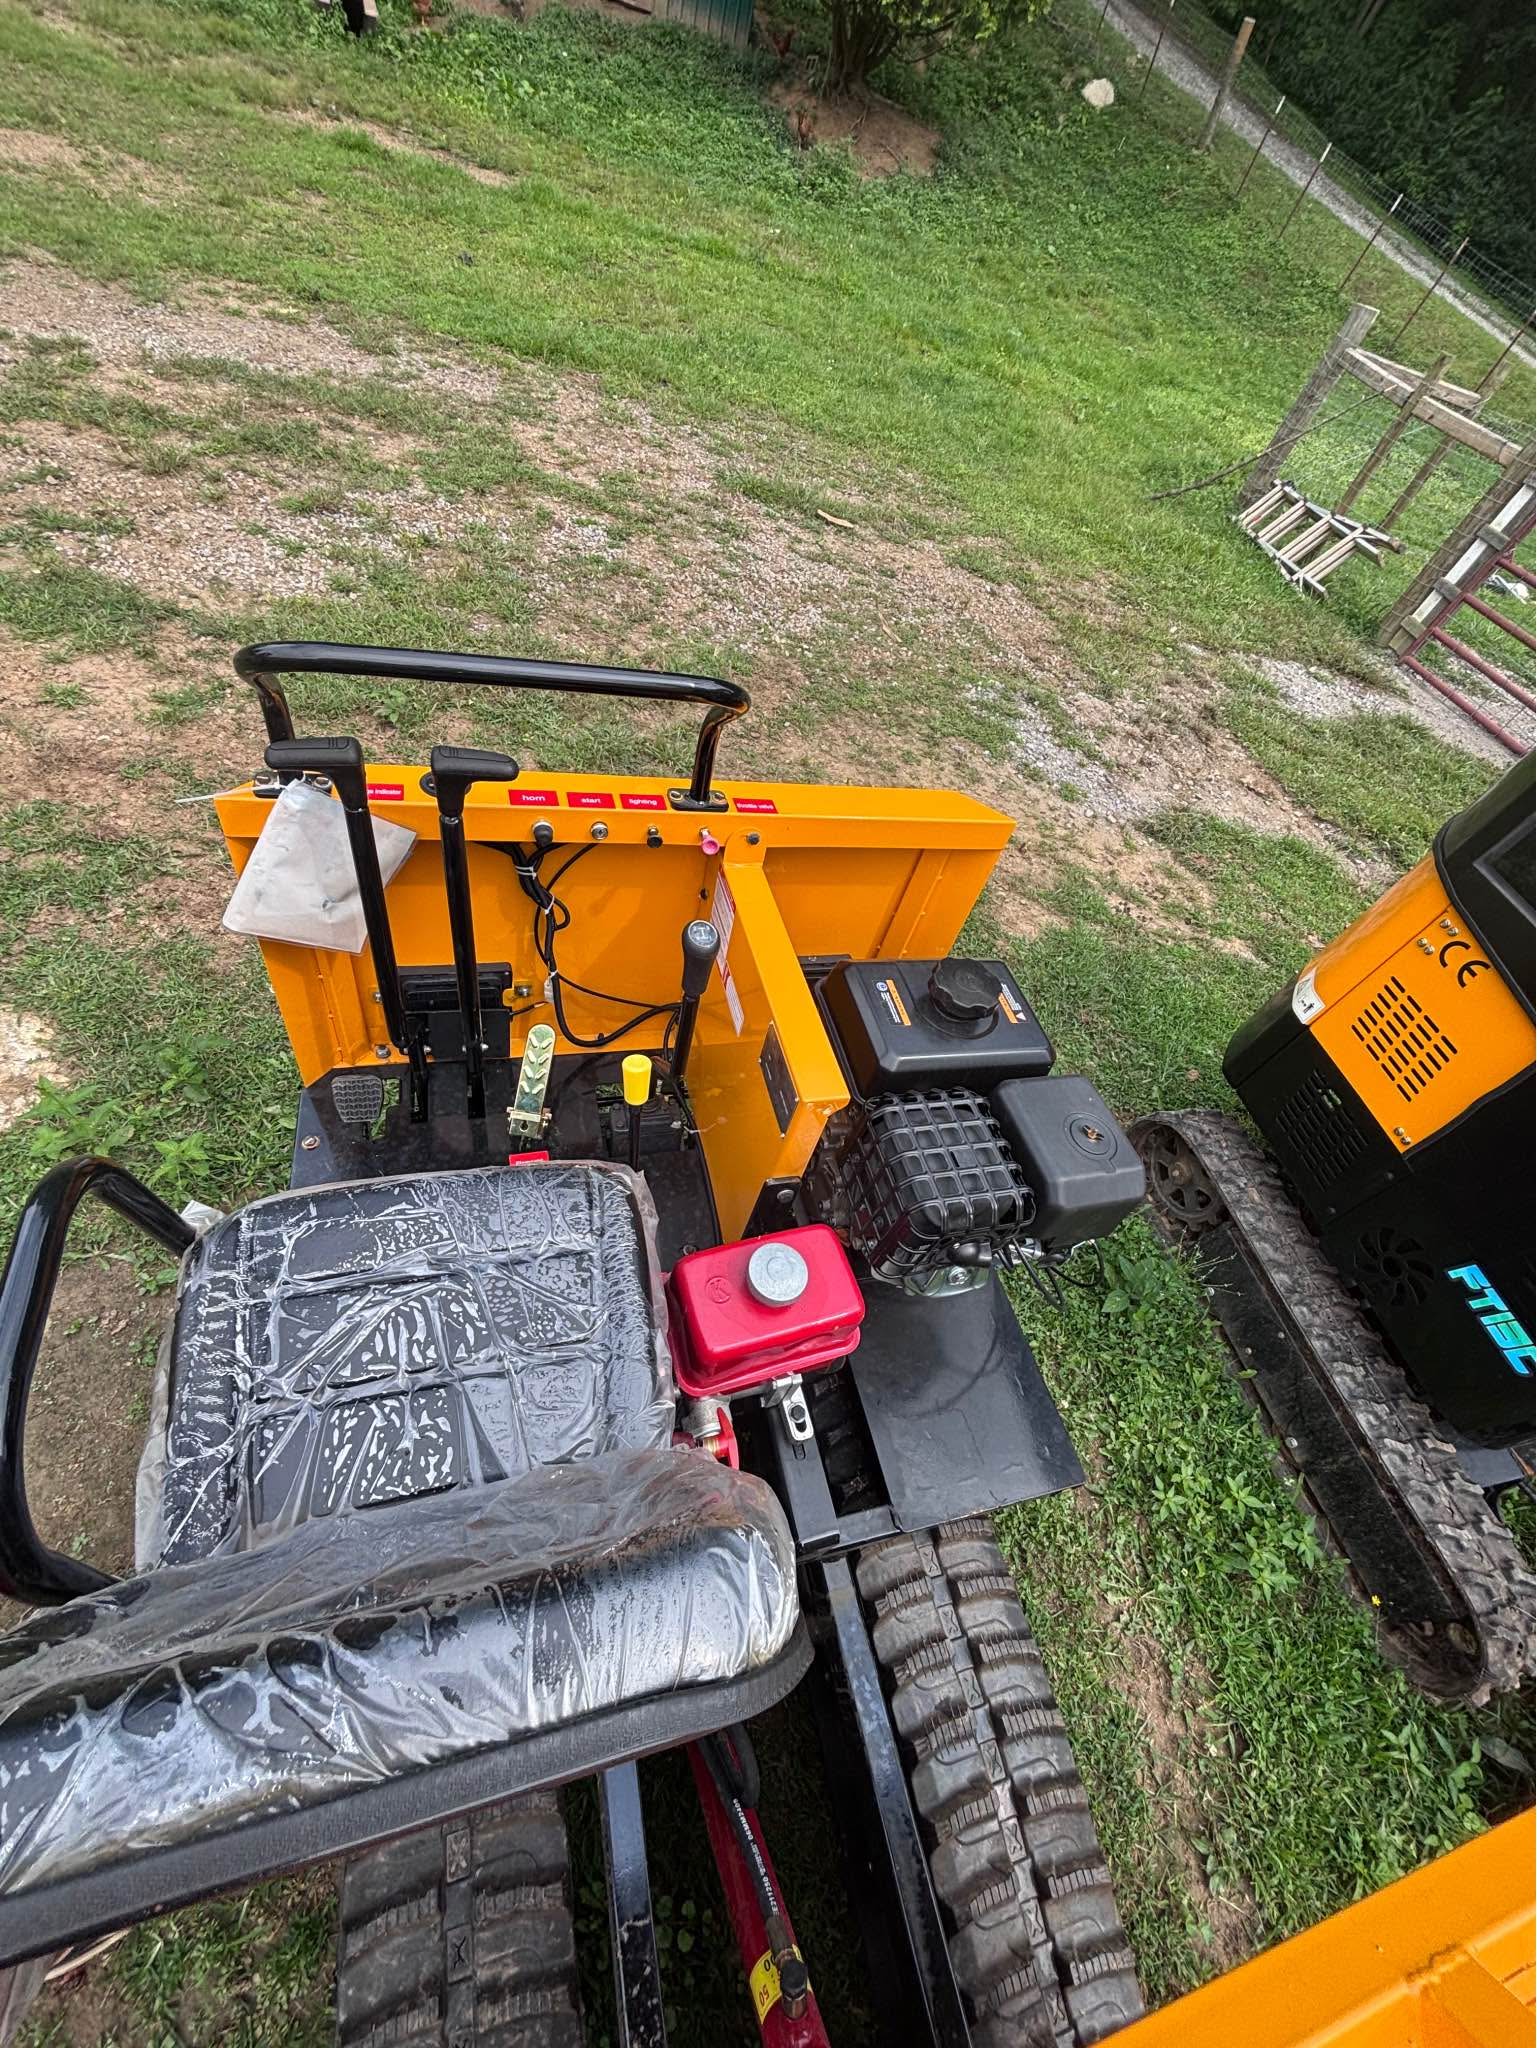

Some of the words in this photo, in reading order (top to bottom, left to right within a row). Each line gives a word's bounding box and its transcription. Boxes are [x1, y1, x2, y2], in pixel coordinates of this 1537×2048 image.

[522, 794, 546, 802] horn
[629, 798, 657, 806] lighting
[1439, 940, 1491, 988] CE
